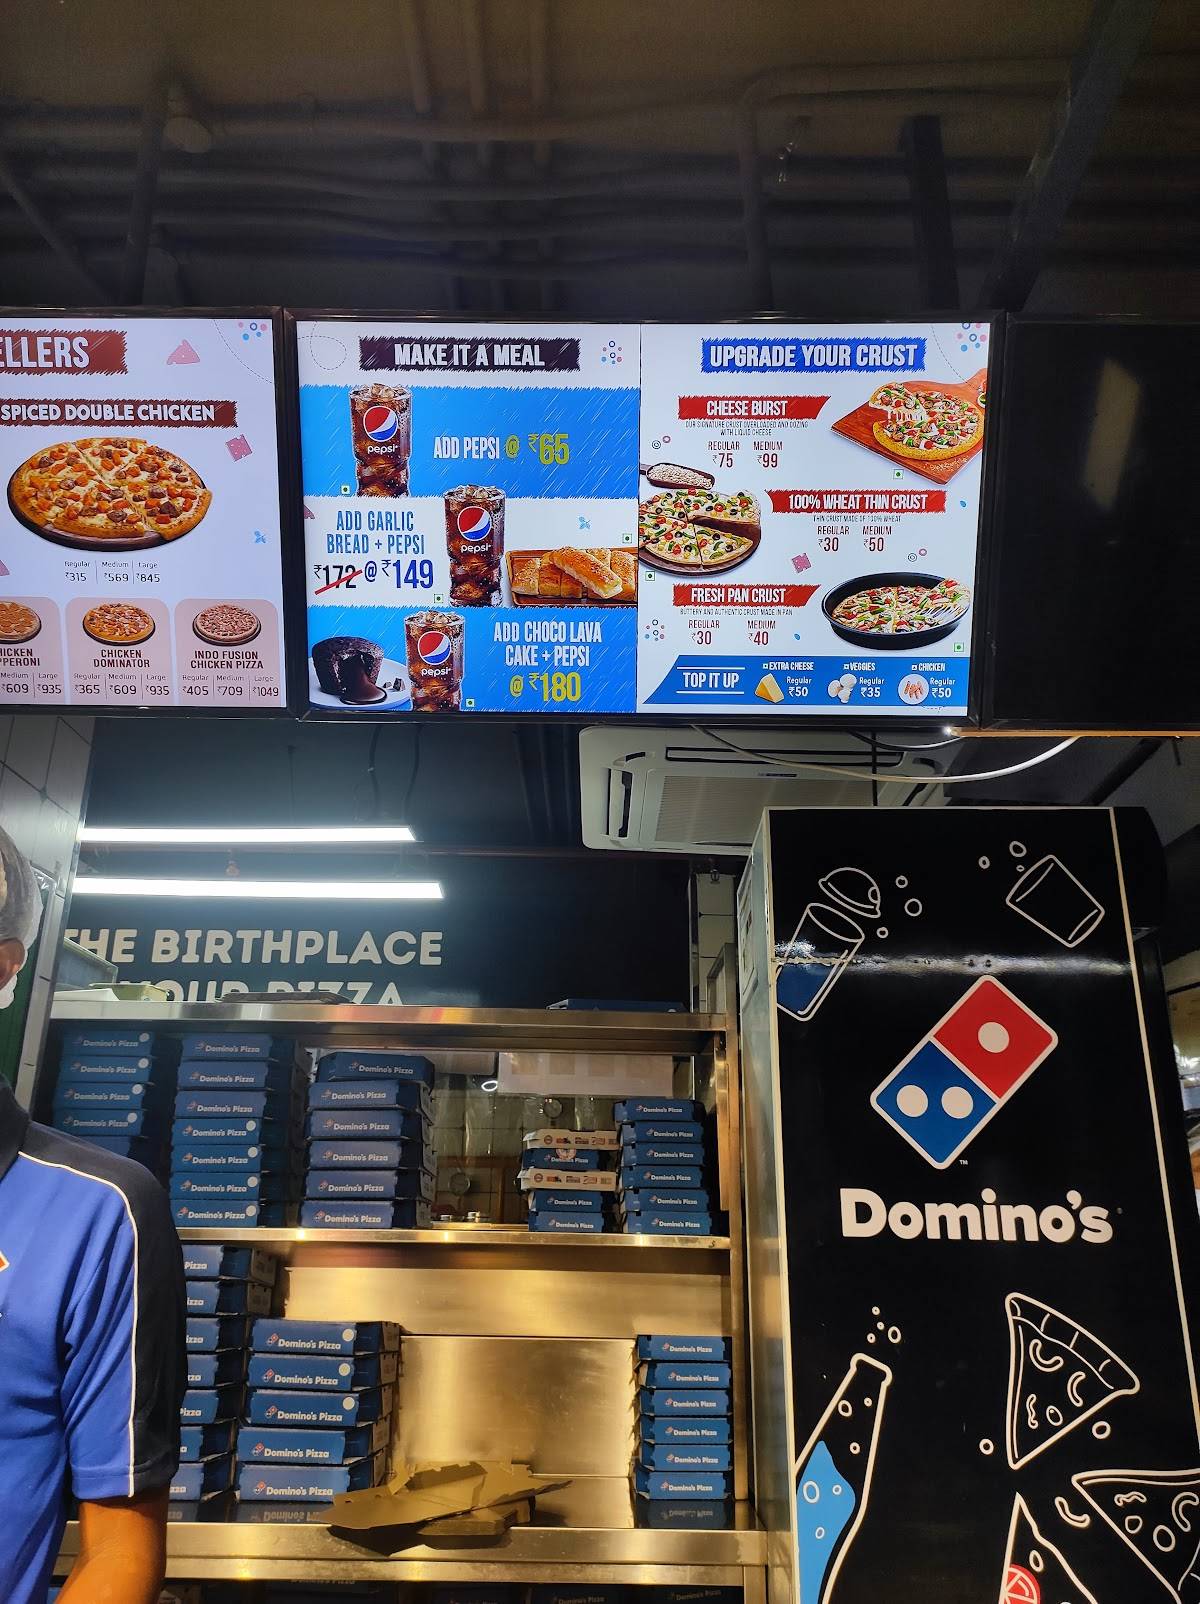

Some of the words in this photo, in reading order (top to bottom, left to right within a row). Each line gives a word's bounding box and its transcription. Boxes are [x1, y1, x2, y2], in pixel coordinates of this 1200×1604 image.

[394, 343, 448, 366] MAKE
[453, 343, 469, 366] IT
[475, 344, 489, 366] A
[494, 344, 546, 366] MEAL
[710, 345, 796, 367] UPGRADE
[802, 345, 850, 367] YOUR
[856, 344, 918, 367] CRUST
[1, 404, 60, 421] SPICED
[65, 404, 134, 421] DOUBLE
[137, 404, 215, 422] CHICKEN
[706, 400, 748, 416] CHEESE
[751, 400, 788, 416] BURST
[367, 445, 395, 455] pepsi
[434, 436, 460, 459] ADD
[463, 436, 500, 459] PEPSI
[505, 434, 520, 459] @
[528, 433, 570, 465] ₹65
[708, 441, 740, 450] REGULAR
[753, 441, 783, 450] MEDIUM
[712, 452, 734, 468] ₹75
[757, 452, 778, 468] ₹99
[789, 494, 820, 510] 100%
[823, 494, 862, 510] WHEAT
[864, 494, 889, 510] THIN
[892, 494, 928, 510] CRUST
[336, 510, 362, 531] ADD
[367, 510, 414, 531] GARLIC
[817, 526, 850, 535] REGULAR
[862, 526, 892, 535] MEDIUM
[327, 534, 369, 554] BREAD
[374, 540, 383, 549] +
[387, 535, 425, 555] PEPSI
[460, 544, 488, 554] pepsi
[818, 537, 839, 552] ₹30
[863, 537, 884, 552] ₹50
[64, 560, 90, 568] Regular
[65, 572, 87, 582] ₹315
[104, 572, 129, 582] ₹569
[136, 573, 160, 582] ₹845
[364, 560, 378, 582] @
[381, 559, 434, 589] ₹149
[691, 588, 724, 603] FRESH
[728, 588, 750, 603] PAN
[752, 588, 786, 603] CRUST
[688, 620, 720, 628] REGULAR
[747, 620, 776, 630] MEDIUM
[494, 621, 520, 642] ADD
[524, 621, 567, 642] CHOCO
[569, 622, 602, 643] LAVA
[691, 630, 712, 645] ₹30
[748, 631, 769, 646] ₹40
[101, 649, 142, 658] CHICKEN
[194, 650, 219, 660] INDO
[222, 651, 258, 660] FUSION
[505, 645, 538, 666] CAKE
[542, 652, 551, 660] +
[554, 645, 590, 667] PEPSI
[94, 658, 150, 668] DOMINATOR
[190, 660, 233, 669] CHICKEN
[236, 660, 264, 669] PIZZA
[769, 662, 790, 670] EXTRA
[790, 662, 814, 672] CHEESE
[850, 662, 876, 672] VEGGIES
[918, 663, 946, 672] CHICKEN
[421, 667, 448, 677] pepsi
[683, 672, 707, 688] TOP
[710, 672, 719, 688] IT
[722, 672, 740, 688] UP
[786, 676, 812, 686] Regular
[858, 676, 885, 686] Regular
[929, 677, 956, 686] Regular
[1, 683, 29, 694] ₹609
[37, 684, 62, 694] ₹935
[74, 684, 100, 694] ₹365
[109, 684, 137, 695] ₹609
[146, 685, 170, 696] ₹935
[182, 686, 209, 696] ₹405
[217, 686, 243, 696] ₹709
[252, 686, 280, 697] ₹1049
[509, 675, 524, 697] @
[528, 672, 581, 702] ₹180
[788, 686, 809, 698] ₹50
[860, 686, 881, 698] ₹35
[931, 687, 952, 698] ₹50
[151, 928, 443, 966] BIRTHPLACE
[366, 1092, 387, 1100] Pizza
[232, 1104, 253, 1114] Pizza
[224, 1210, 246, 1220] Pizza
[324, 1214, 359, 1223] Domino's
[360, 1215, 382, 1224] Pizza
[839, 1187, 1114, 1244] Domino's
[184, 1261, 208, 1270] Pizza
[278, 1338, 317, 1349] Domino's
[318, 1338, 342, 1350] Pizza
[274, 1374, 313, 1384] Domino's
[314, 1374, 338, 1385] Pizza
[264, 1448, 304, 1458] Domino's
[305, 1448, 330, 1458] Pizza
[266, 1486, 306, 1496] Domino's
[308, 1486, 333, 1496] Pizza
